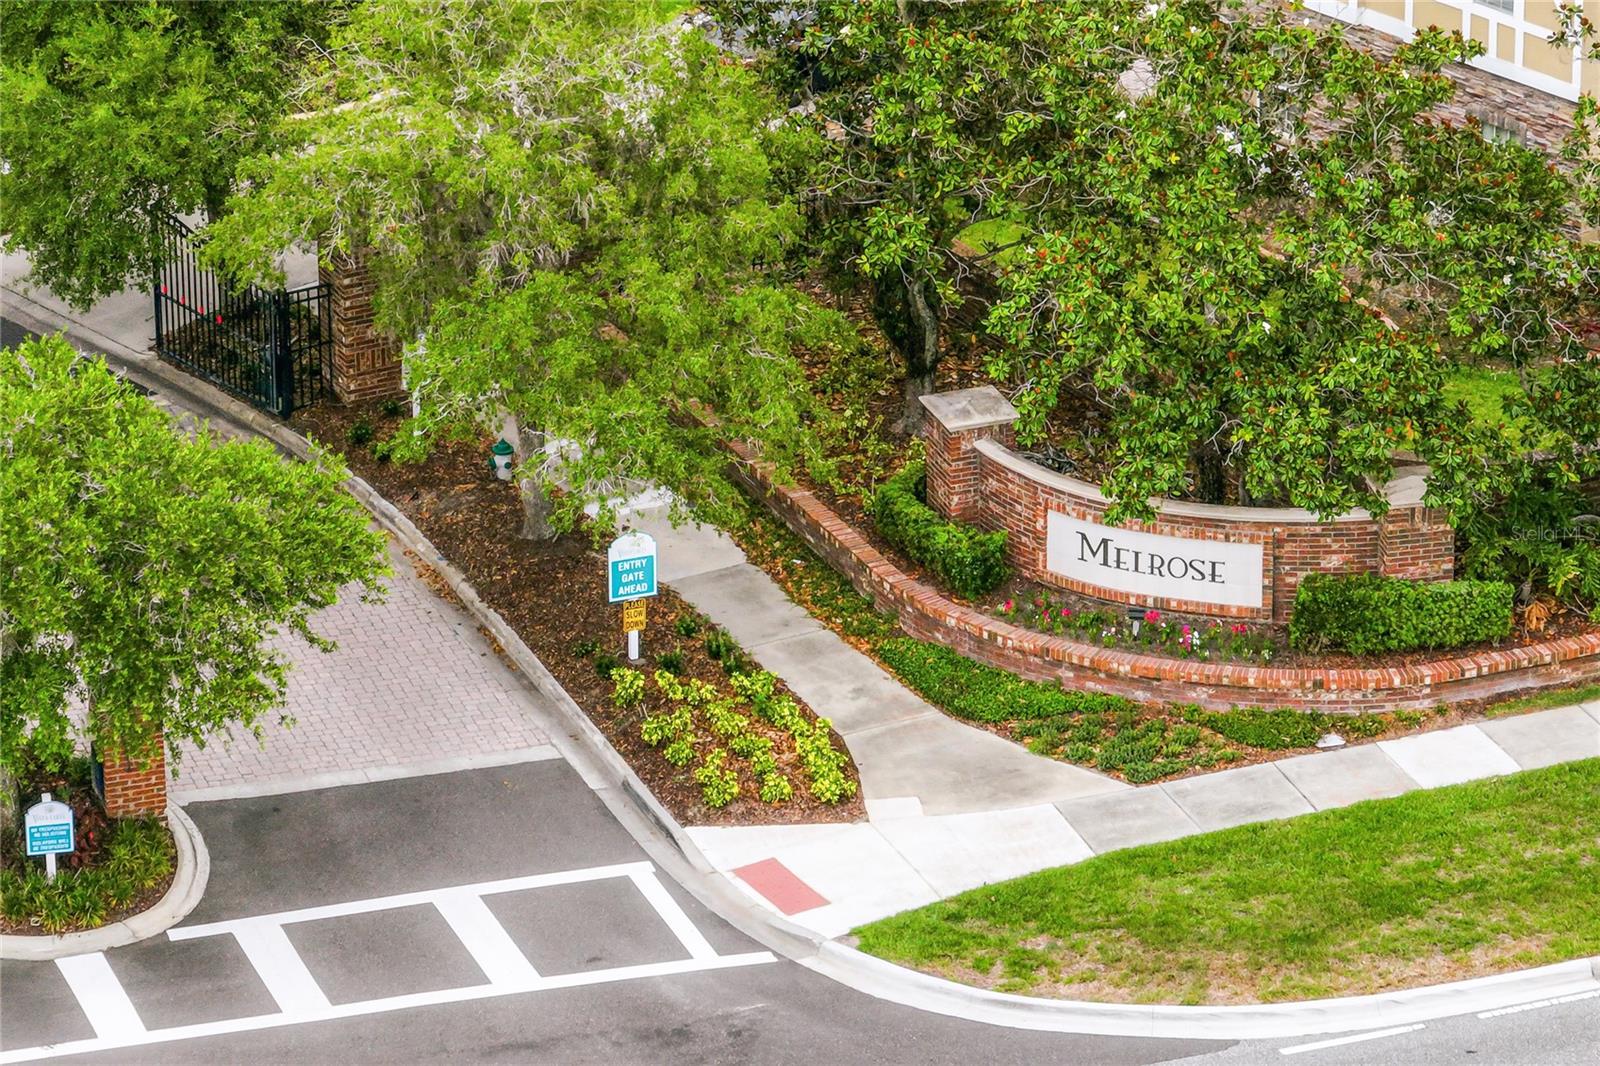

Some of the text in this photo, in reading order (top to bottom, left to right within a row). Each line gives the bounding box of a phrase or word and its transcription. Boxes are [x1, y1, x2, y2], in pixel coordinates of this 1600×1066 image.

[1076, 531, 1225, 584] MELROSE
[618, 559, 647, 572] ENTRY
[621, 571, 644, 583] GATE
[618, 583, 648, 595] AHEAD
[626, 610, 644, 619] SLOW
[626, 619, 644, 629] DOWN
